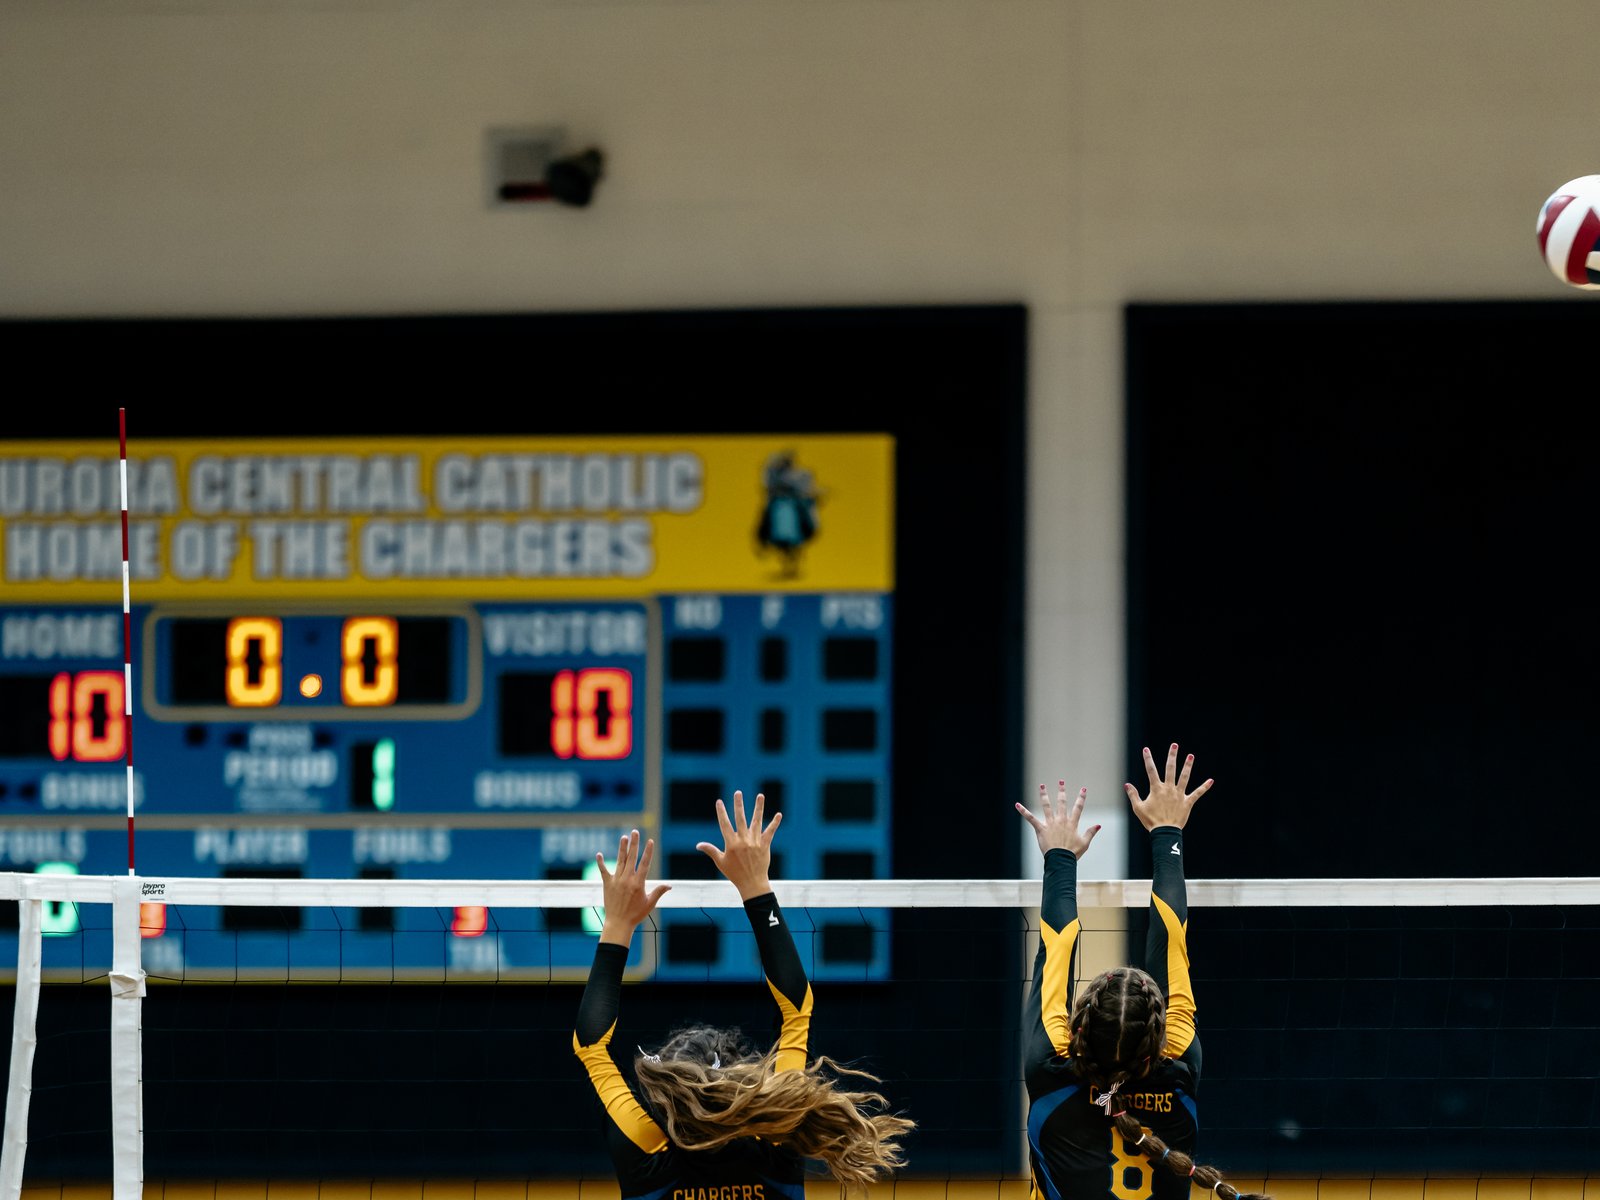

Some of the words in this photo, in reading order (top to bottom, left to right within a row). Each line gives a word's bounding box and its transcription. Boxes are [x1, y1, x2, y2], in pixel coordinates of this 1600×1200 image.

[190, 456, 426, 513] CENTRAL
[435, 454, 703, 514] CATHOLIC
[6, 521, 161, 580] HOME
[172, 520, 238, 580] OF
[249, 520, 351, 580] THE
[360, 518, 655, 580] CHARGERS
[3, 617, 120, 658] HOME
[484, 612, 646, 656] VISITOR
[49, 671, 128, 762] 10
[551, 668, 632, 760] 10
[1089, 1085, 1173, 1112] CRGERS
